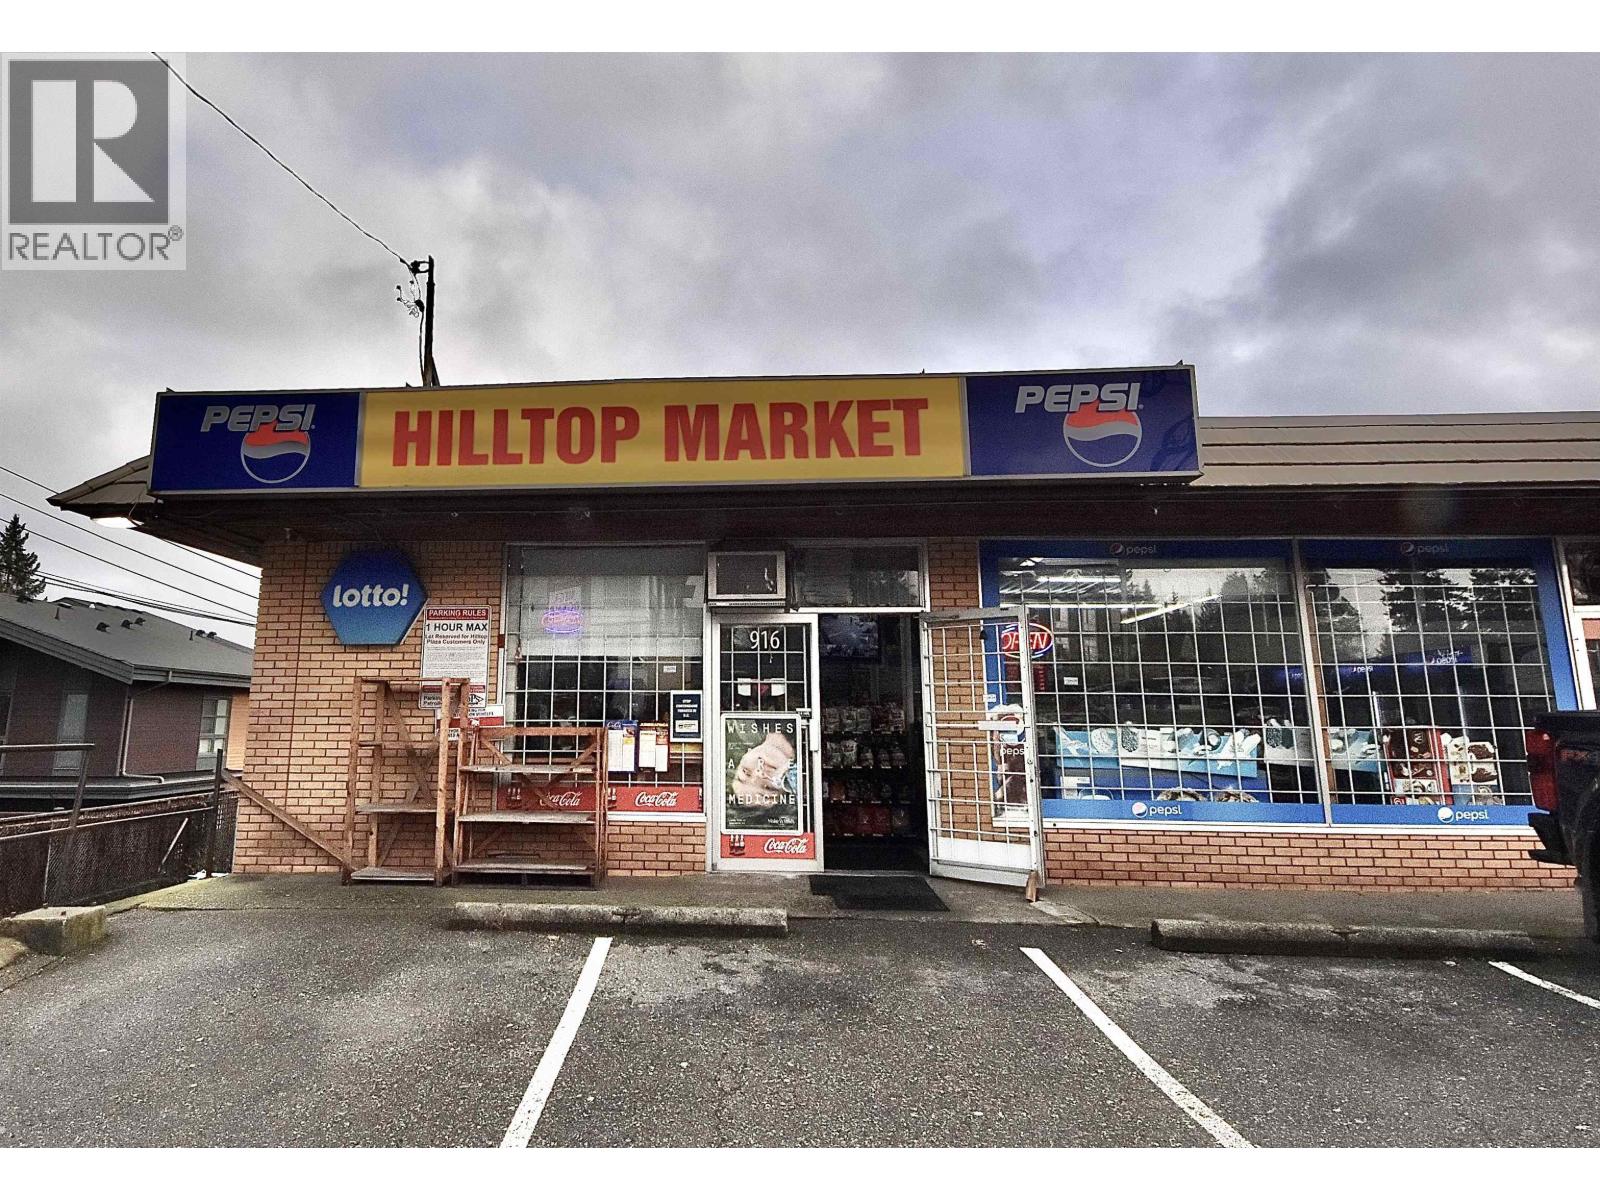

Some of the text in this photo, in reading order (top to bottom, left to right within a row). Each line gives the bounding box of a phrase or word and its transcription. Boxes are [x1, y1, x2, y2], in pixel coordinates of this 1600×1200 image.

[1015, 382, 1140, 413] PEPSI
[199, 404, 316, 432] PEPSI
[392, 397, 928, 466] HILLTOP MARKET
[428, 609, 487, 617] PARKING RULES
[425, 623, 488, 632] 1 HOUR MAX
[749, 630, 780, 649] 916
[727, 722, 795, 734] WISHES
[1000, 747, 1025, 756] peps
[728, 793, 797, 805] MEDICINE
[1149, 804, 1183, 817] pepsi
[1455, 809, 1489, 822] pepsi
